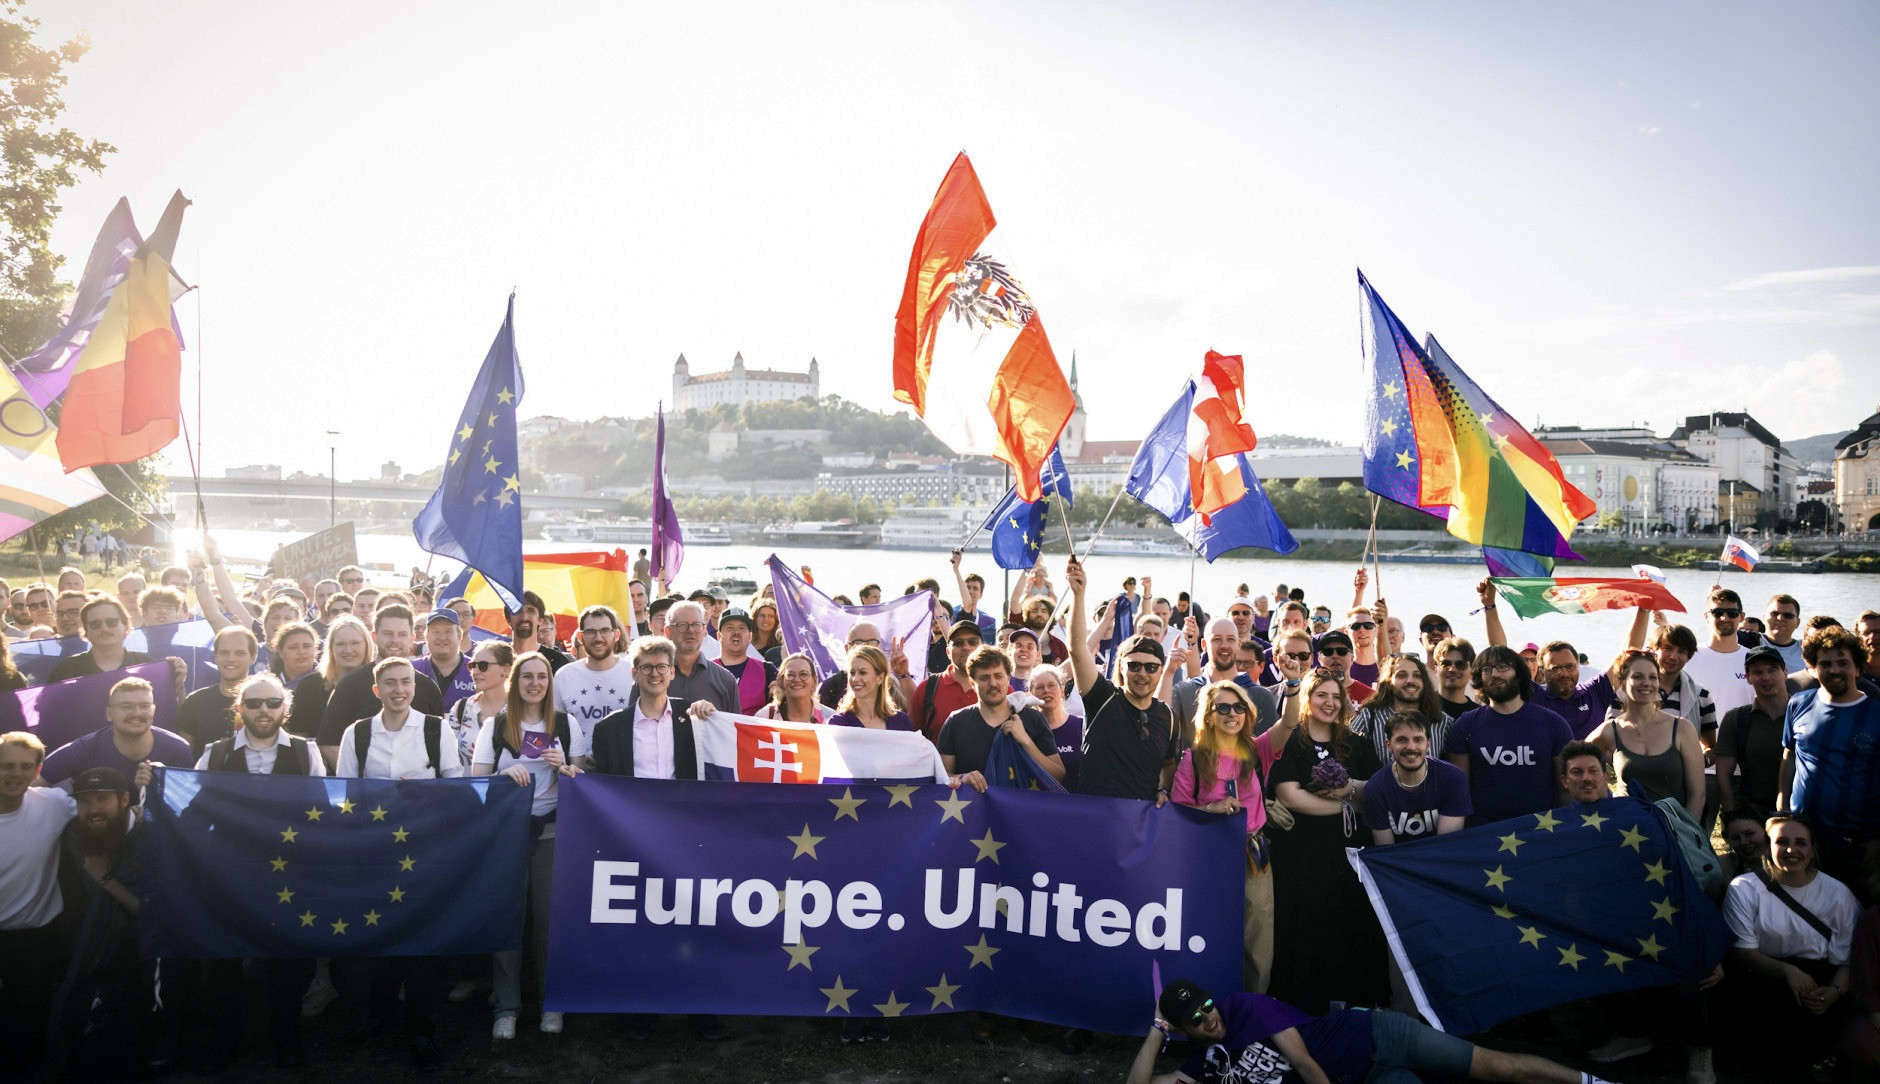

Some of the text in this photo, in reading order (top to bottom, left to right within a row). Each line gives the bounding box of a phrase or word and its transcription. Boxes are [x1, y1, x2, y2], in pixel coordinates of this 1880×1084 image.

[284, 541, 351, 580] EMPOWER
[580, 705, 613, 720] Volt
[1057, 745, 1074, 753] Volt
[1480, 745, 1536, 766] Volt
[590, 861, 1207, 954] Europe. United.
[1246, 1046, 1280, 1084] RSCH
